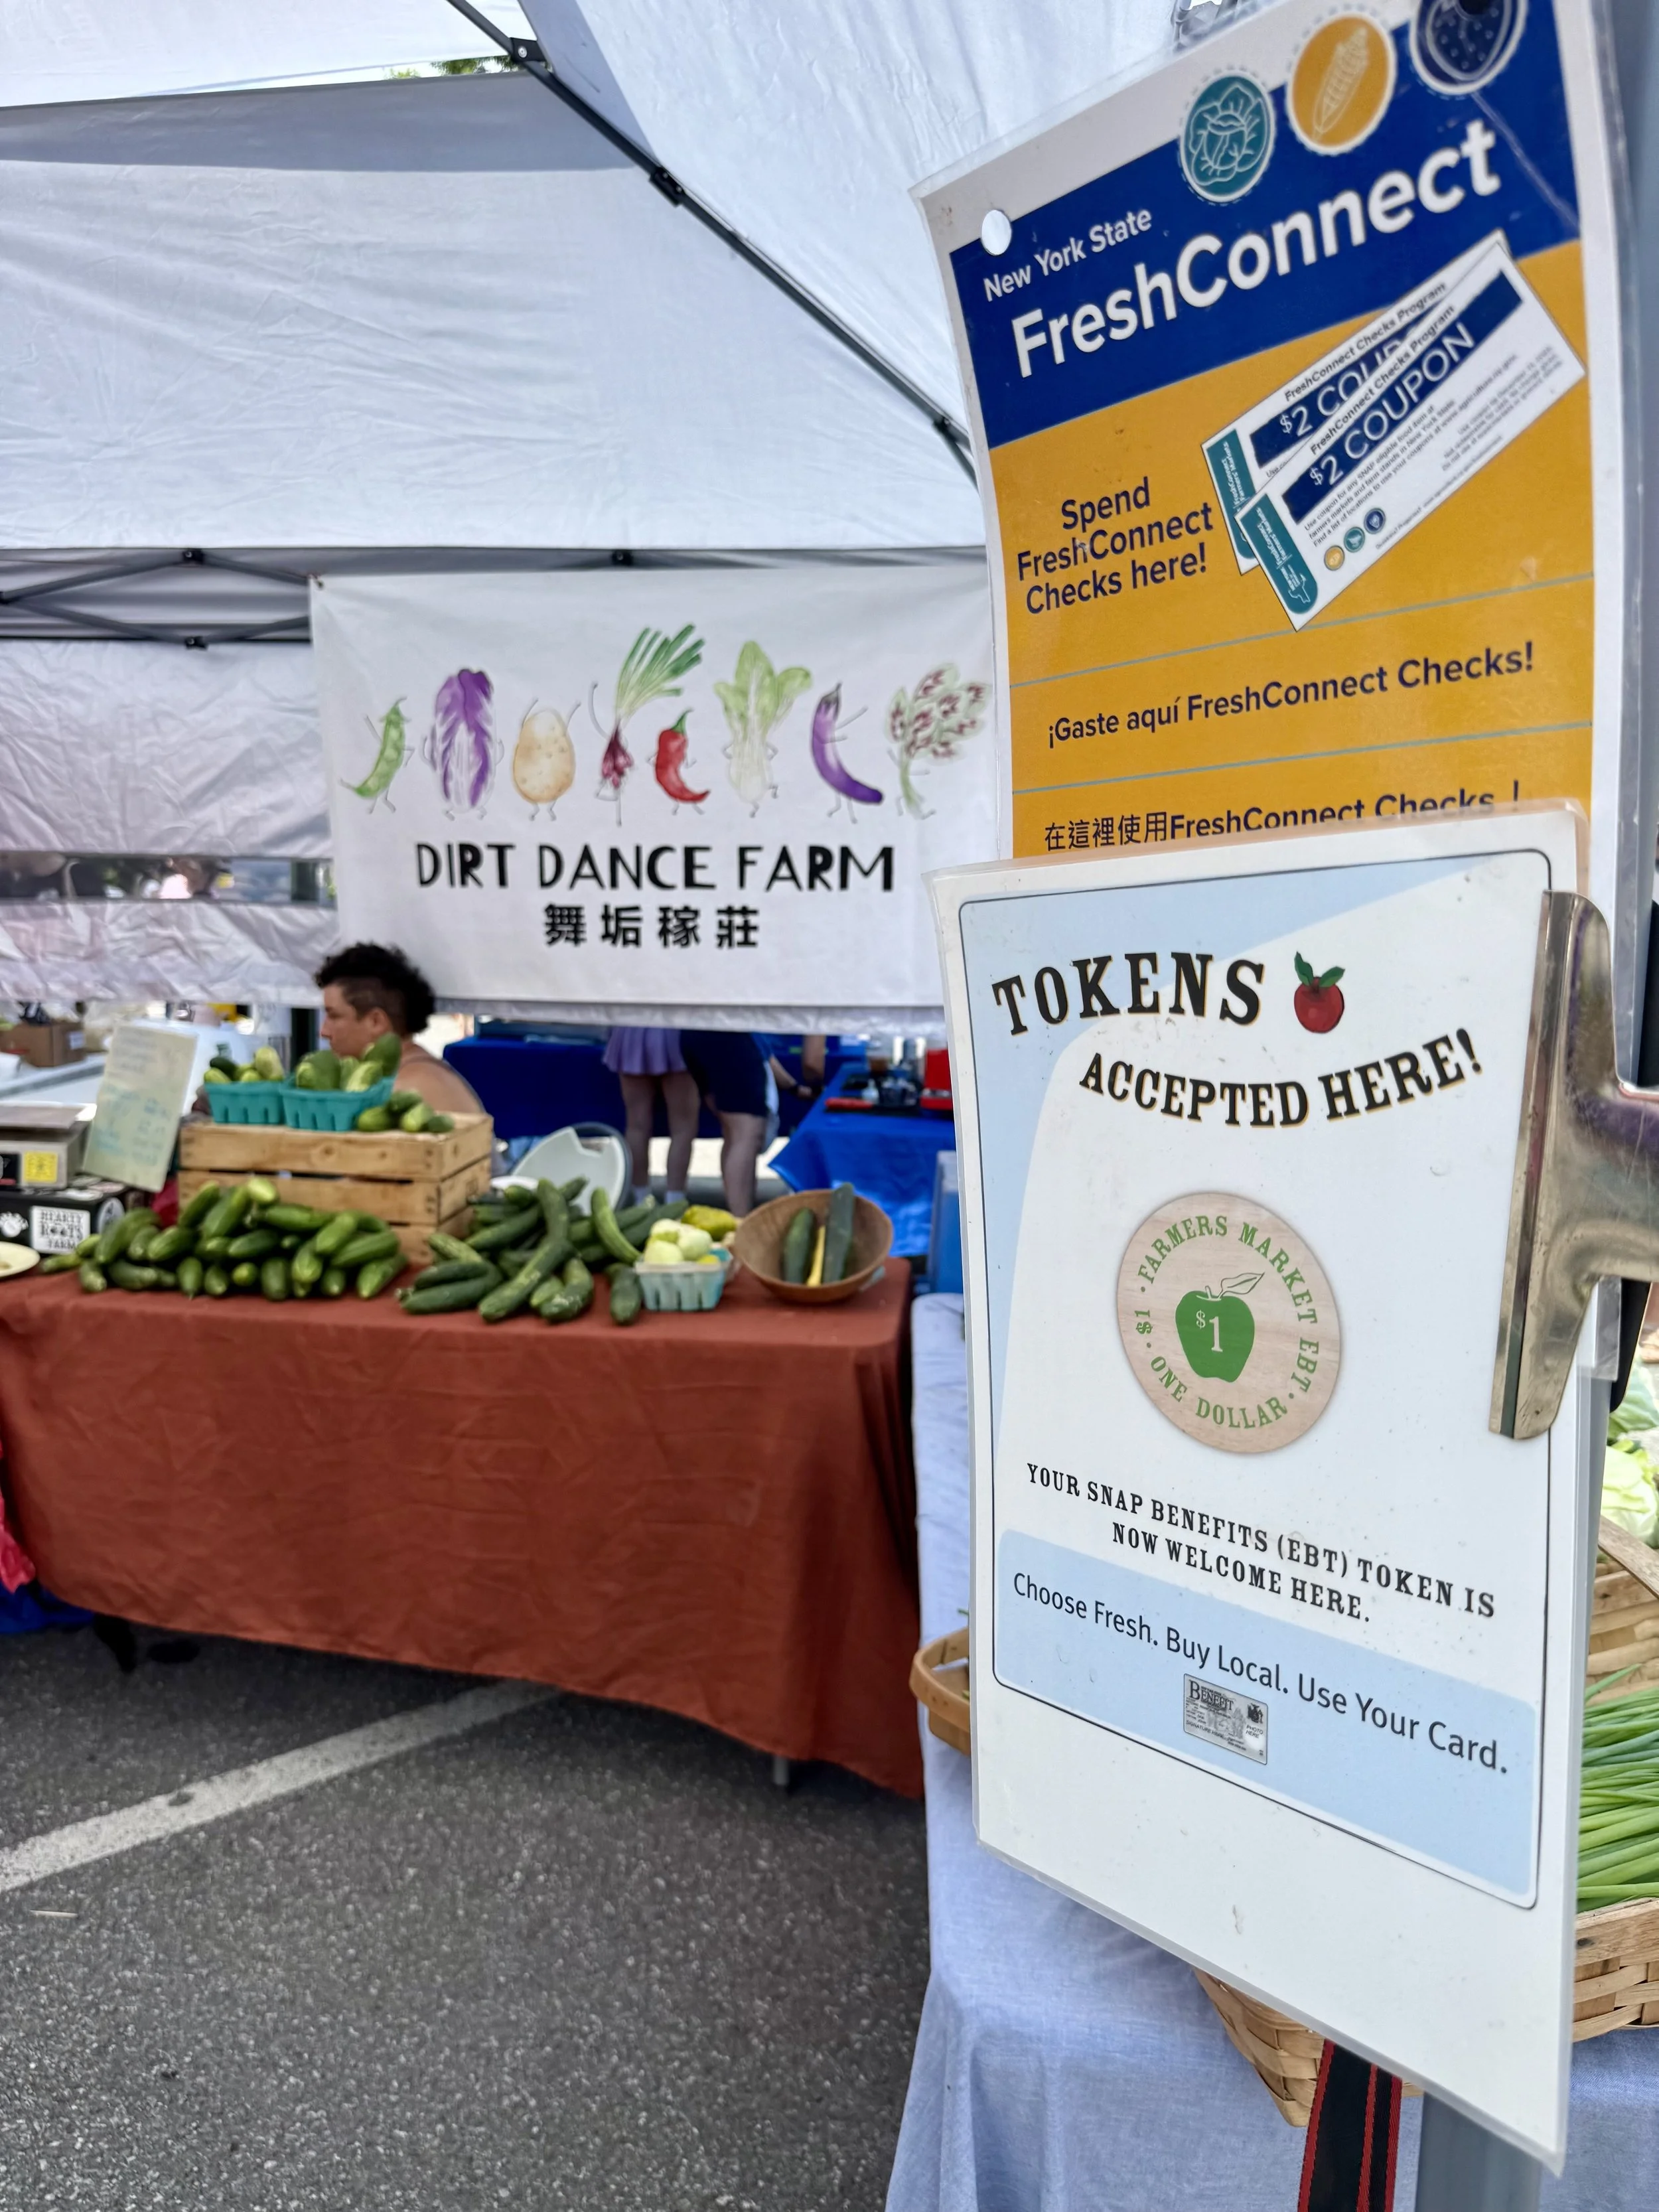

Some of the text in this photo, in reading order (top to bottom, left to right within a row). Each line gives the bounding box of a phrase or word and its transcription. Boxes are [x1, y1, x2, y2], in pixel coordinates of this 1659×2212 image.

[983, 209, 1152, 302] New York State
[1011, 119, 1501, 378] FreshConnect
[1285, 283, 1446, 402] FreshConnect Checks Program
[1311, 306, 1454, 455] FreshConnect Checks Program
[1280, 406, 1313, 436] $2
[1309, 454, 1344, 486] $2
[1344, 323, 1475, 459] COUPON
[1017, 502, 1213, 581] FreshConnect
[1062, 476, 1150, 532] Spend
[1304, 517, 1317, 532] Use
[1316, 497, 1338, 522] coupon
[1336, 488, 1346, 500] for
[1309, 516, 1331, 540] farmers
[1330, 495, 1353, 520] markets
[1352, 483, 1366, 498] and
[1313, 532, 1327, 548] Find
[1027, 542, 1206, 614] Checks here!
[1048, 642, 1534, 748] ¡Gaste aquí FreshConnect Checks!
[416, 843, 894, 892] DIRT DANCE FARM
[991, 952, 1265, 1036] TOKENS
[1079, 1027, 1484, 1129] ACCEPTED HERE!
[1135, 1309, 1153, 1335] $1
[1137, 1215, 1319, 1392] FARMERS MARKET EBT
[1196, 1310, 1223, 1353] $1
[1151, 1356, 1287, 1429] ONE DOLLAR
[1027, 1463, 1495, 1618] YOUR SNAP BENEFITS (EBT) TOKEN IS
[1112, 1522, 1370, 1623] NOW WELCOME HERE.
[1013, 1572, 1510, 1776] Choose Fresh. Buy Local. Use Your Card.
[1189, 1680, 1234, 1710] BENEFIT
